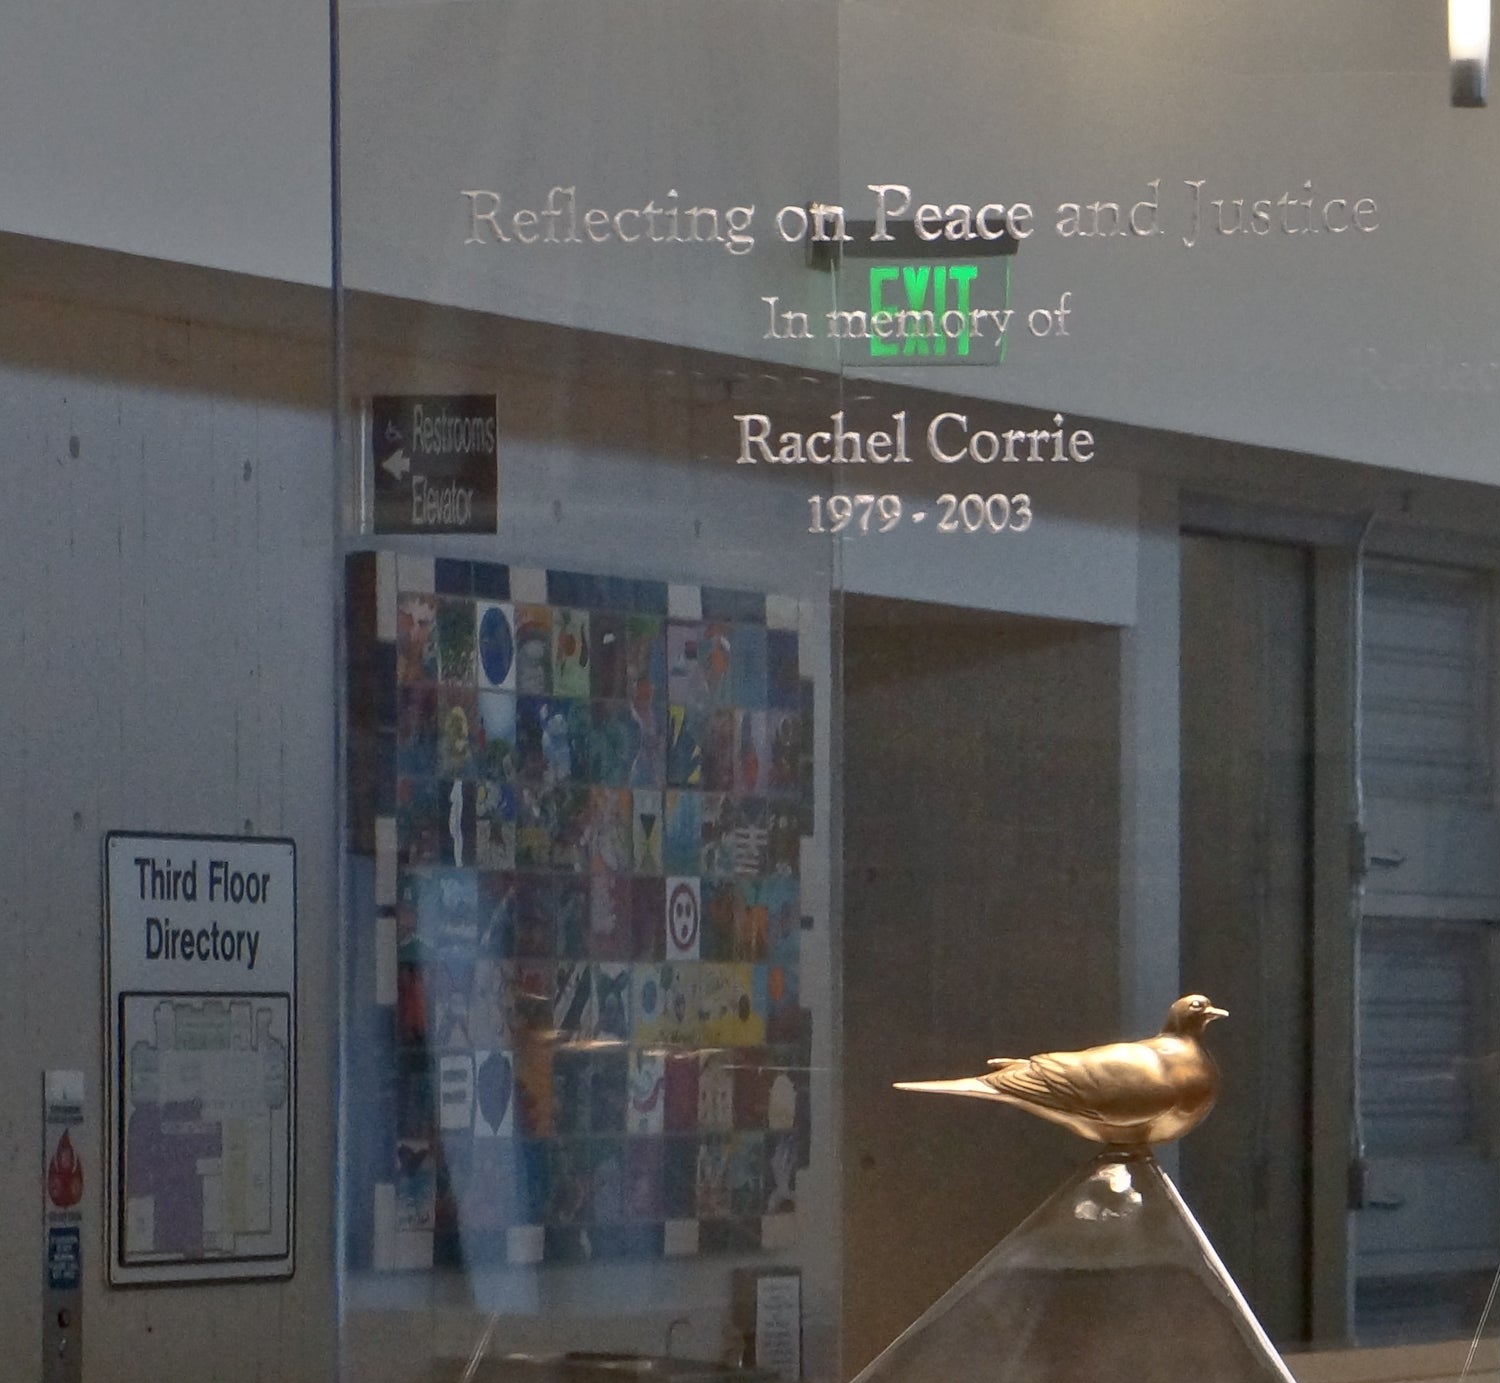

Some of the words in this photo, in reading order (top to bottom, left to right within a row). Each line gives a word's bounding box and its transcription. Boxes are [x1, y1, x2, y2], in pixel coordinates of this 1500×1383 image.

[461, 186, 755, 254] Reflecting
[777, 202, 853, 242] on
[867, 184, 1034, 241] Peace
[1056, 178, 1164, 238] and
[1183, 178, 1381, 248] Justice
[761, 297, 814, 340] In
[827, 308, 1014, 347] memory
[1028, 292, 1072, 337] of
[870, 265, 977, 357] EXIT
[412, 404, 496, 456] Restrooms
[733, 411, 913, 465] Rachel
[927, 412, 1095, 463] Corrie
[412, 475, 474, 527] Elevator
[807, 494, 902, 535] 1979
[936, 492, 1034, 534] 2003
[135, 856, 198, 904] Third
[208, 860, 271, 905] Floor
[145, 918, 261, 970] Directory
